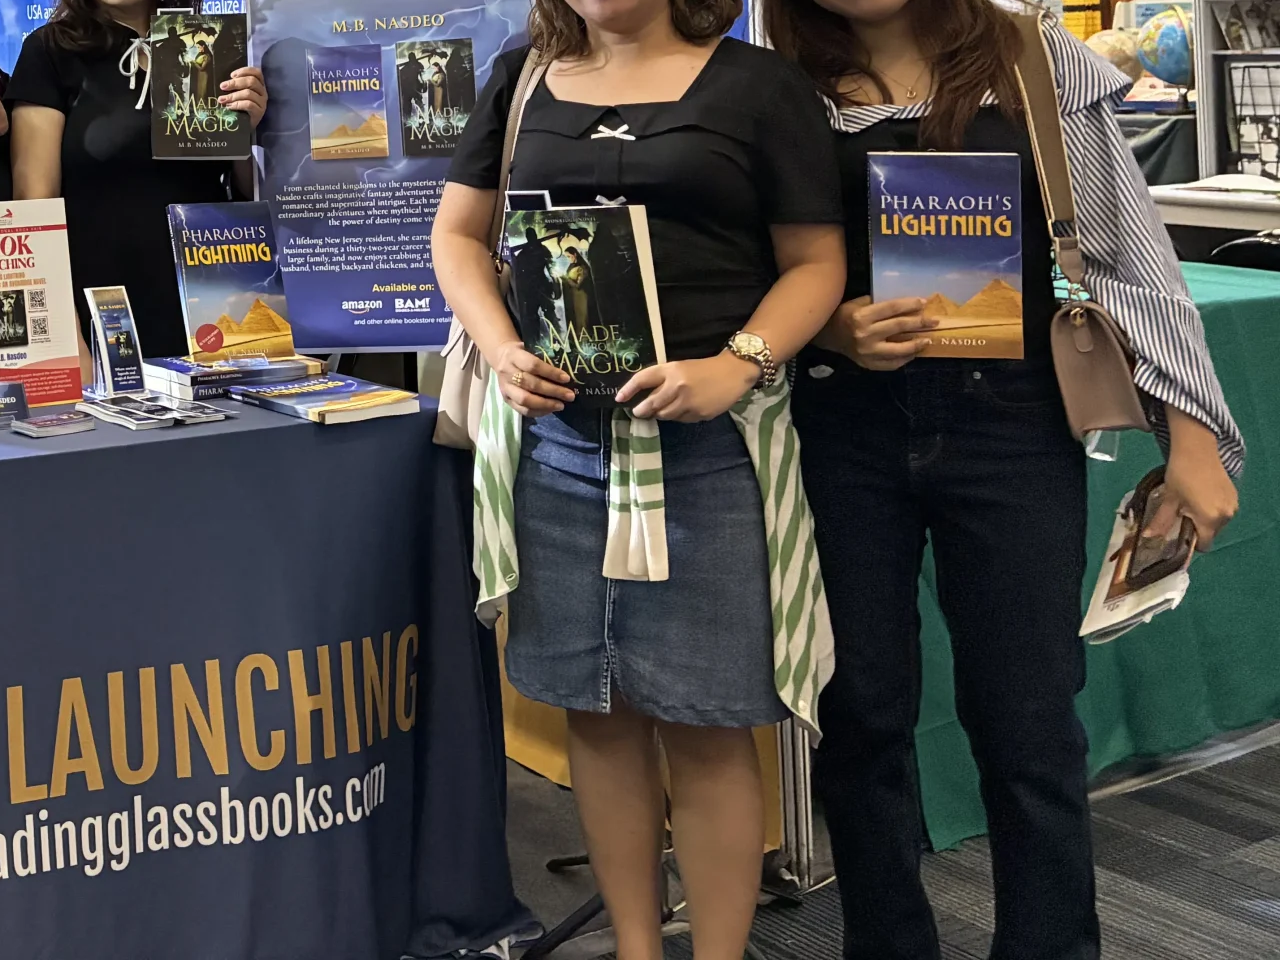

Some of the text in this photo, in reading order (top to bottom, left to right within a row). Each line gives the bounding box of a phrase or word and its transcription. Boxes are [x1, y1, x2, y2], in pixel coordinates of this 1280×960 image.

[27, 5, 42, 20] USA
[332, 14, 446, 34] M.B. NASDEO
[312, 66, 379, 80] PHARAOH'S
[312, 77, 380, 94] LIGHTNING
[416, 104, 461, 125] MADE
[165, 111, 239, 140] MAGIC
[283, 184, 302, 192] From
[304, 182, 341, 191] enchanted
[342, 181, 377, 191] kingdoms
[388, 180, 401, 188] the
[402, 178, 437, 189] mysteries
[276, 188, 434, 202] Nasdeo crafts imaginative fantasy adventures
[315, 197, 428, 210] and supernatural intrigue. Each
[881, 194, 1012, 211] PHARAOH'S
[278, 205, 422, 220] extraordinary adventures where mythical
[328, 215, 423, 228] the power of destiny come
[881, 214, 1012, 237] LIGHTNING
[182, 226, 267, 243] PHARAOH'S
[296, 234, 410, 246] lifelong New Jersey resident, she
[185, 242, 272, 266] LIGHTNING
[283, 246, 313, 254] business
[314, 245, 339, 254] during
[346, 244, 399, 253] thirty-two-year
[401, 243, 420, 251] career
[287, 255, 306, 264] large
[307, 254, 331, 263] family,
[332, 254, 346, 262] and
[347, 253, 362, 261] now
[364, 252, 388, 262] enjoys
[389, 251, 421, 260] crabbing
[312, 260, 424, 272] tending backyard chickens, and
[372, 283, 435, 293] Available on:
[342, 300, 383, 311] amazon
[395, 298, 431, 309] BAM!
[404, 317, 435, 325] bookstore
[541, 317, 620, 355] MADE
[941, 337, 986, 346] NASDEO
[535, 346, 643, 385] MAGIC
[5, 623, 420, 806] LAUNCHING
